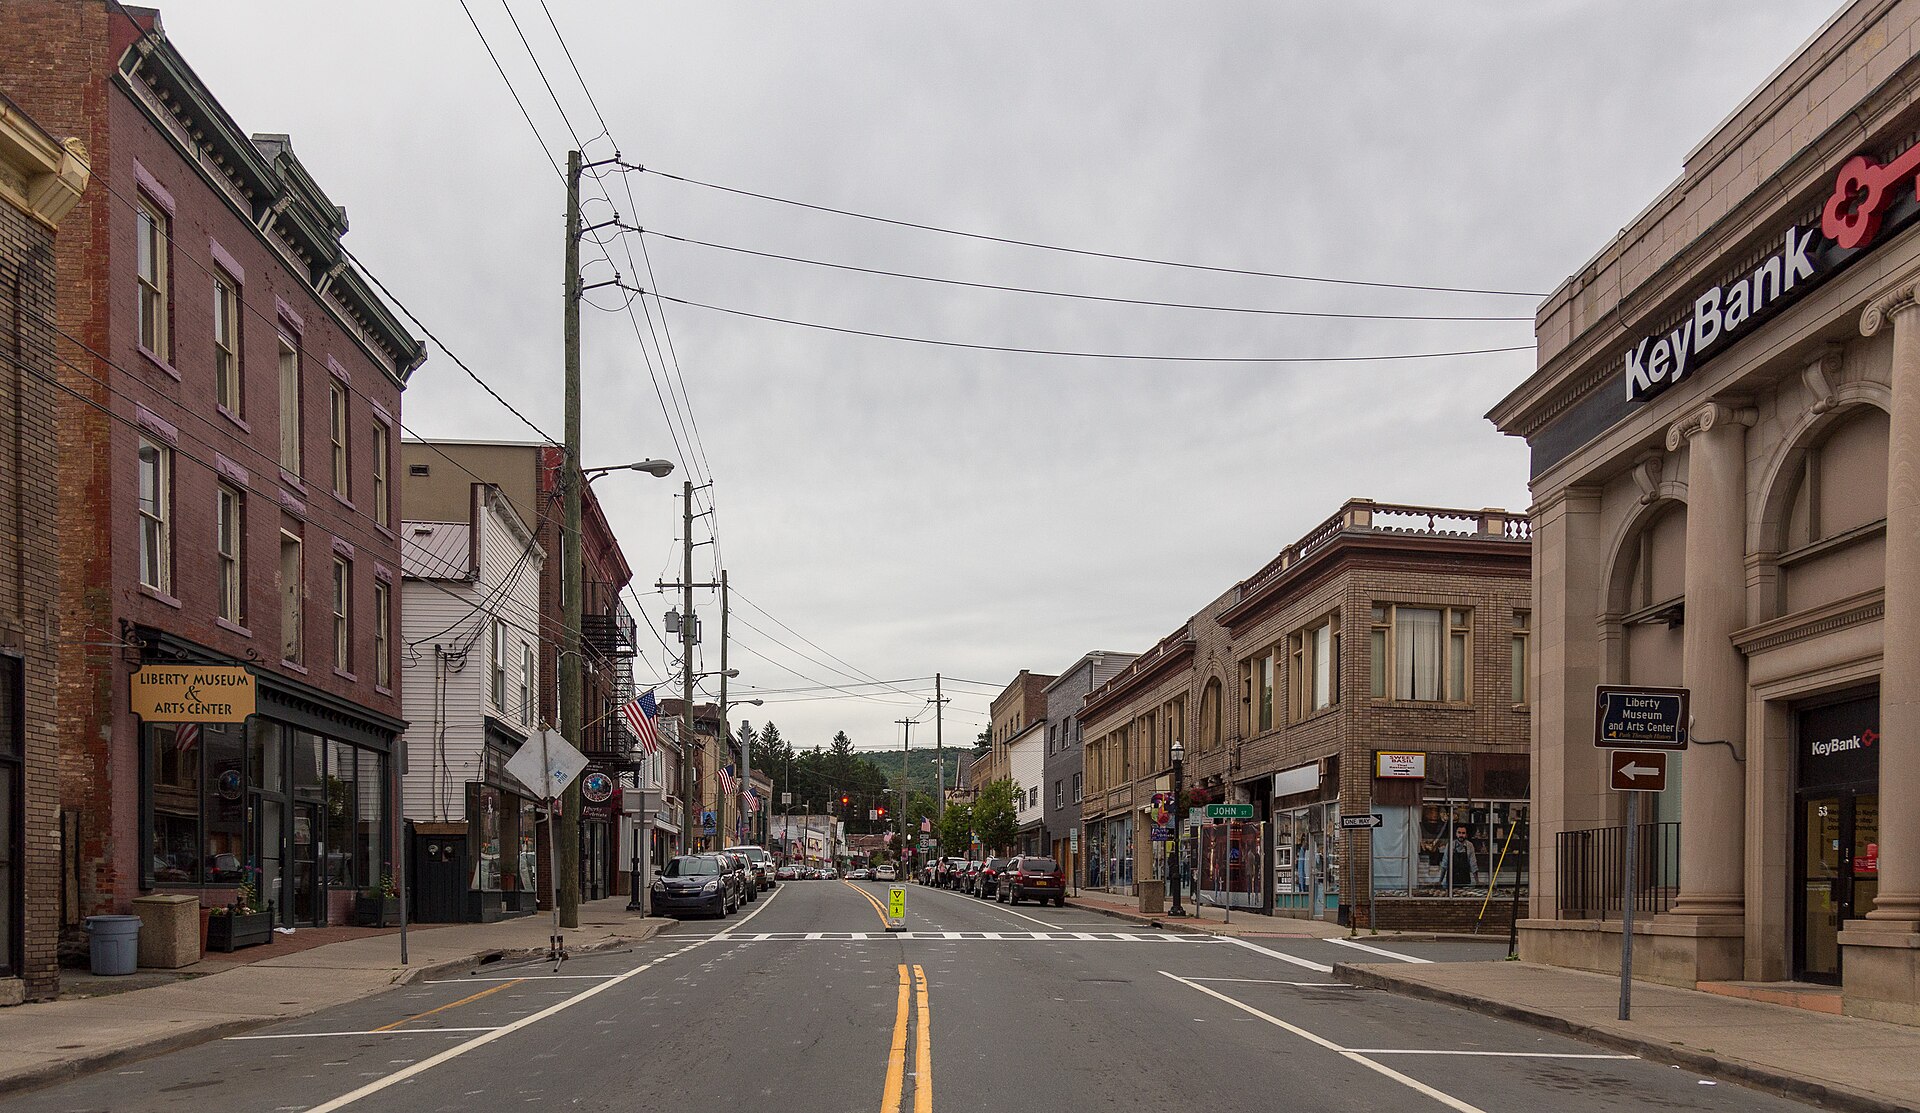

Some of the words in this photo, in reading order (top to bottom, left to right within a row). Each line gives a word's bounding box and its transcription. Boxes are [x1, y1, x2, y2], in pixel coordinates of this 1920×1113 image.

[1625, 226, 1814, 402] KeyBank
[140, 673, 189, 685] LIBERTY
[193, 674, 249, 686] MUSEUM
[184, 685, 202, 703] &
[154, 702, 185, 714] ARTS
[187, 703, 232, 715] CENTER
[1625, 697, 1660, 710] Liberty
[1622, 709, 1662, 720] Museum
[1608, 721, 1623, 731] and
[1627, 721, 1644, 731] Arts
[1647, 722, 1675, 733] Center
[1812, 735, 1861, 756] KeyBank
[1213, 807, 1237, 816] JOHN
[1818, 805, 1828, 817] 53
